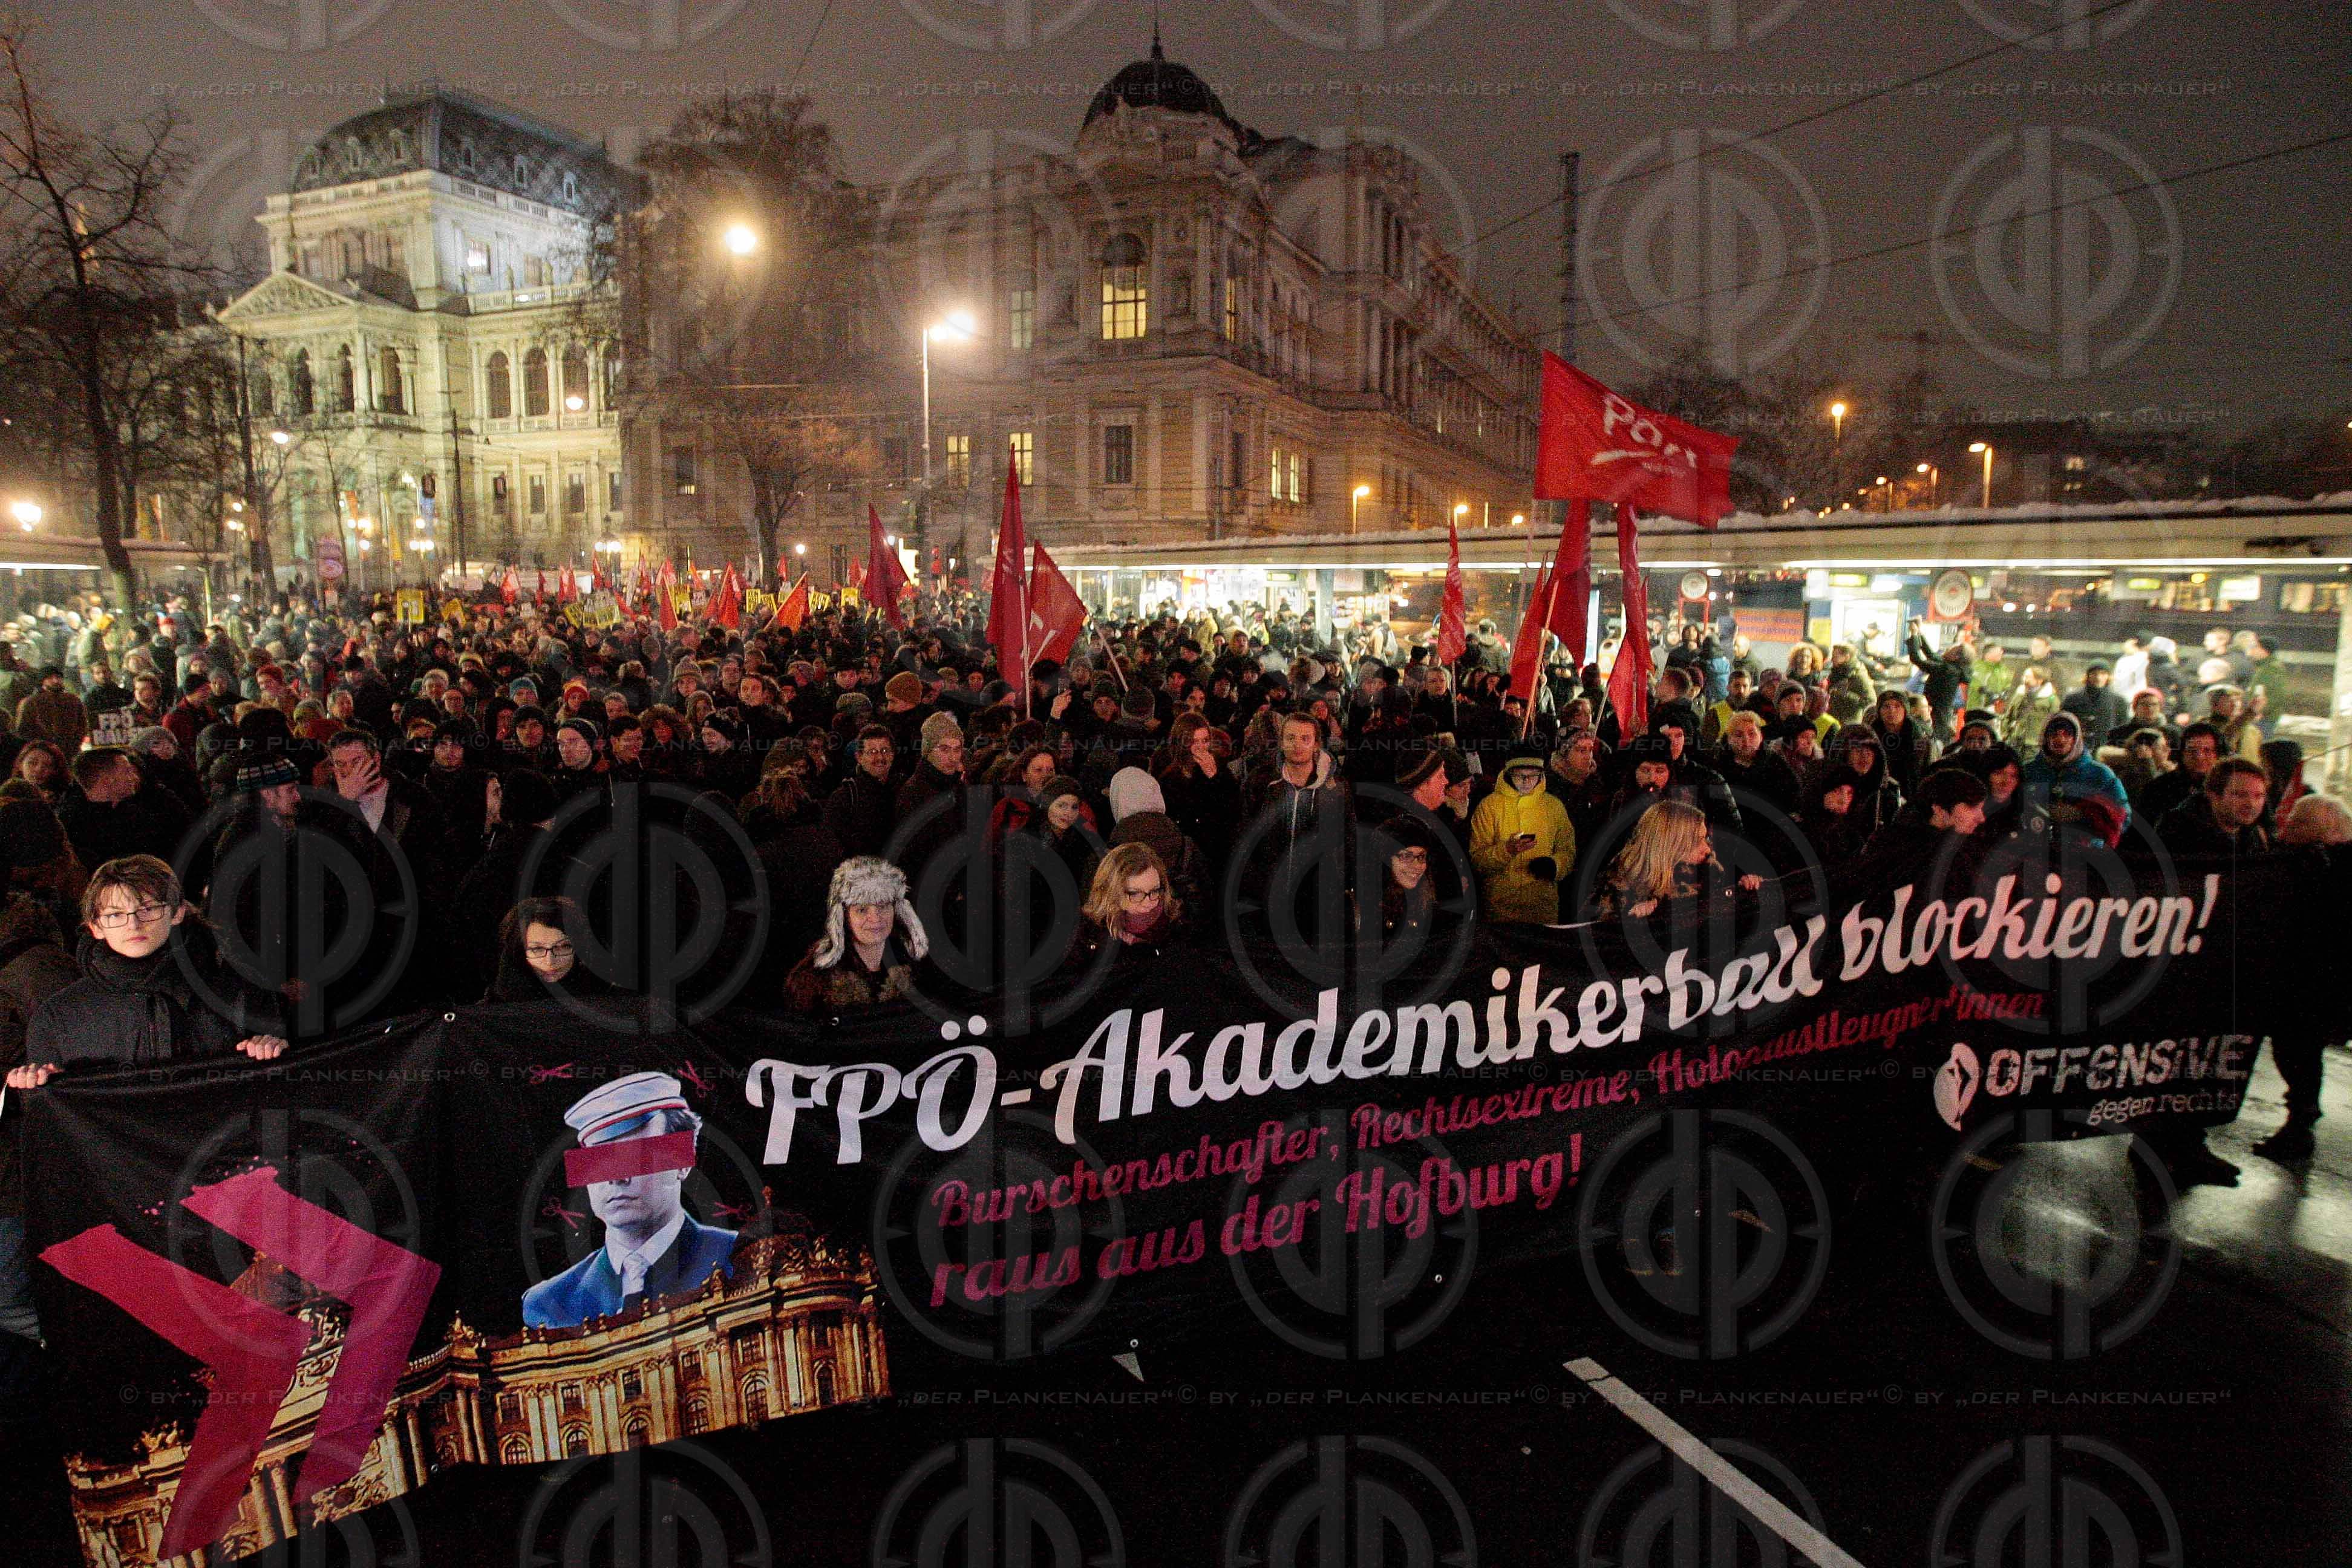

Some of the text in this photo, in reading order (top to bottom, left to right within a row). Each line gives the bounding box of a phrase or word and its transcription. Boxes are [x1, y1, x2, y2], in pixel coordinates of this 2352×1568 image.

[1840, 873, 2220, 982] blockieren!
[932, 1120, 1339, 1227] Burschenschafter,
[1351, 1071, 1641, 1148] Rechtsextreme,
[2086, 1096, 2156, 1126] gegen
[930, 1134, 1583, 1307] raus aus der Hofburg!
